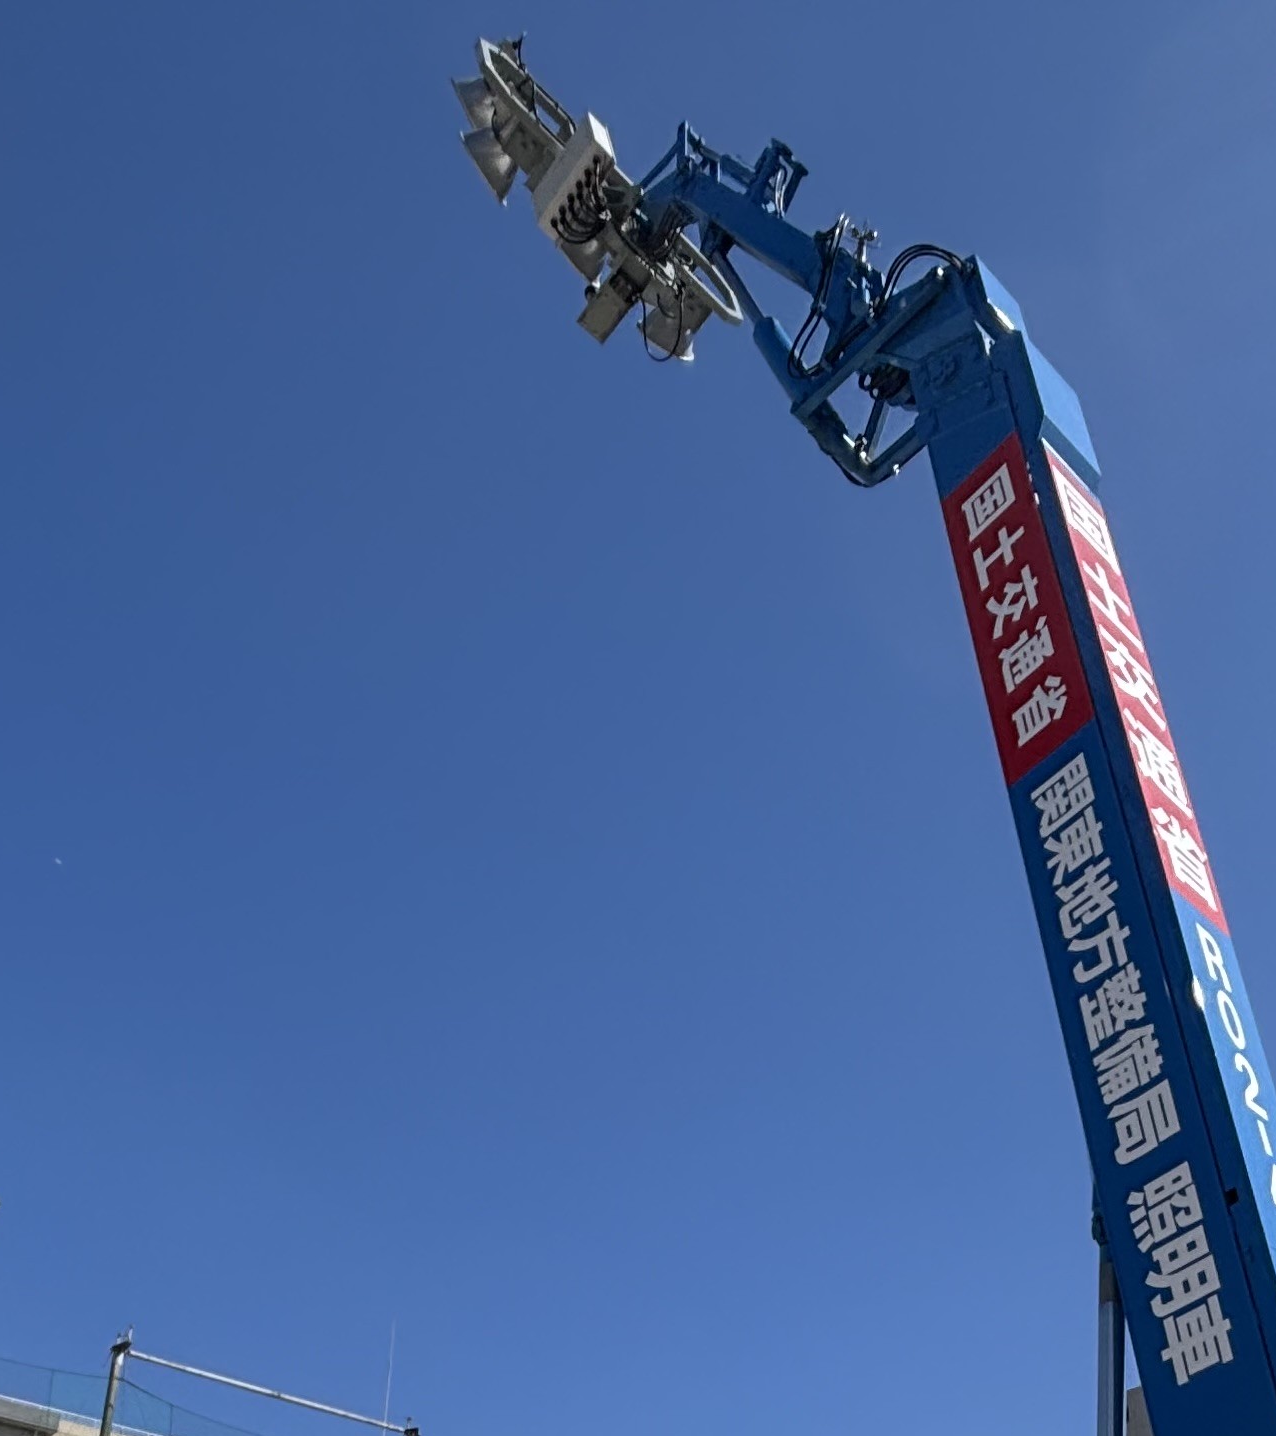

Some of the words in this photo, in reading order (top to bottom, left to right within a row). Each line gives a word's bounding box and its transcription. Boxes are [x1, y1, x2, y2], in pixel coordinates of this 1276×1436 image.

[961, 463, 1068, 747] 国土交通省
[1051, 464, 1218, 911] 国土交通省
[1030, 753, 1181, 1165] 関東地方整備局
[1127, 1161, 1234, 1386] 照明車
